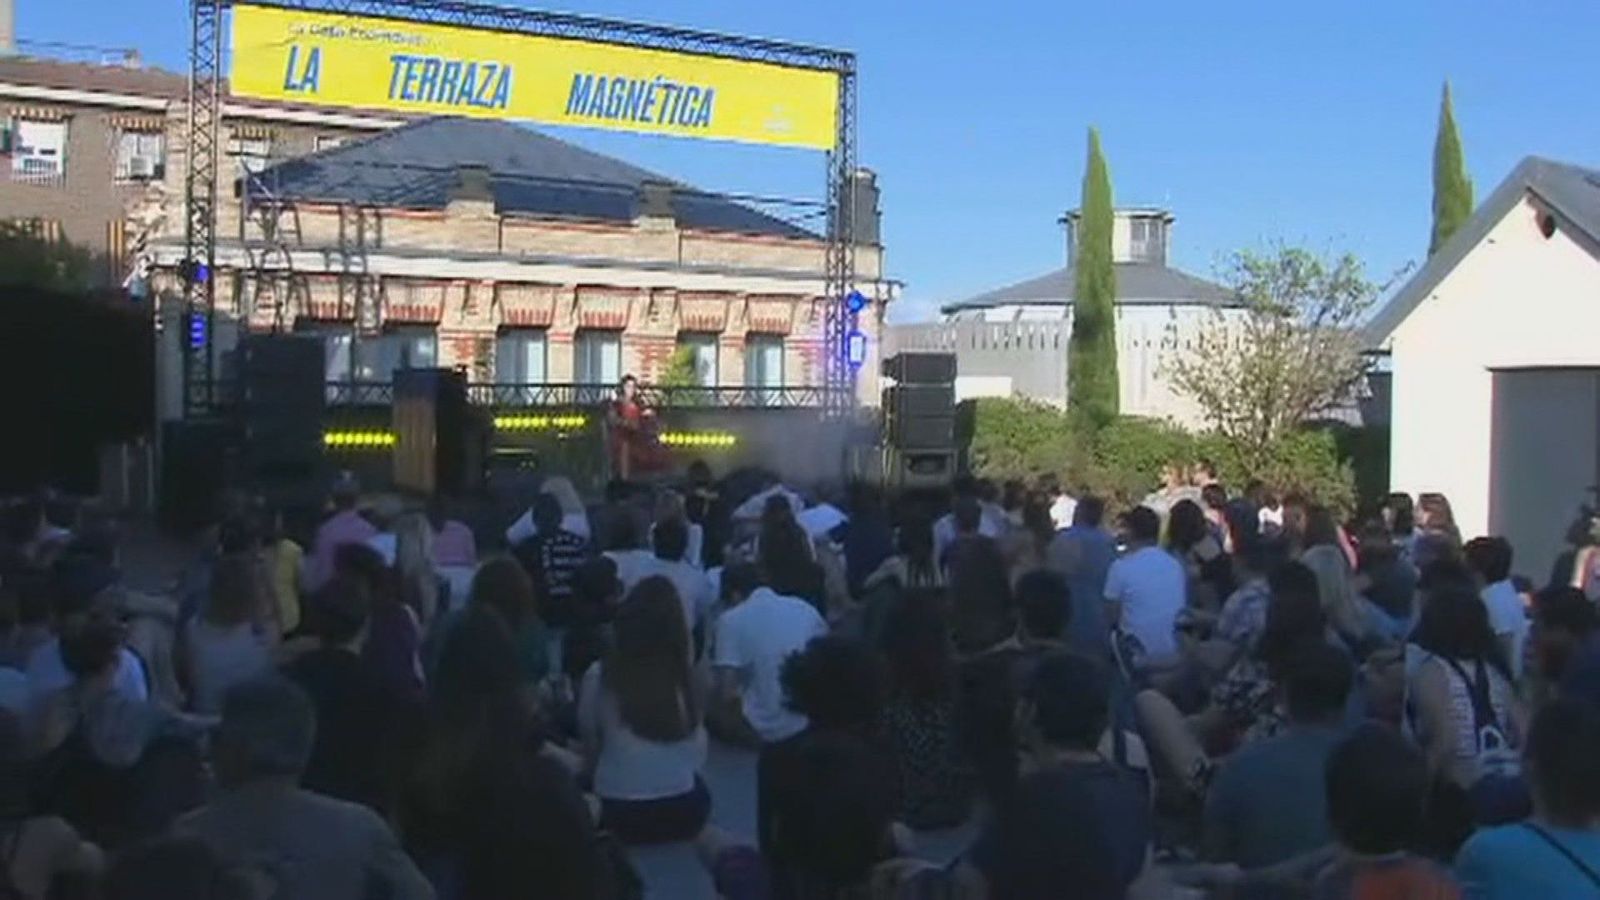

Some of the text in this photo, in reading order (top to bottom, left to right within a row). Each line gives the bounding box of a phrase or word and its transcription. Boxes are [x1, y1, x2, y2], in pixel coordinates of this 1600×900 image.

[283, 45, 714, 127] LA TERRAZA MAGNÉTICA
